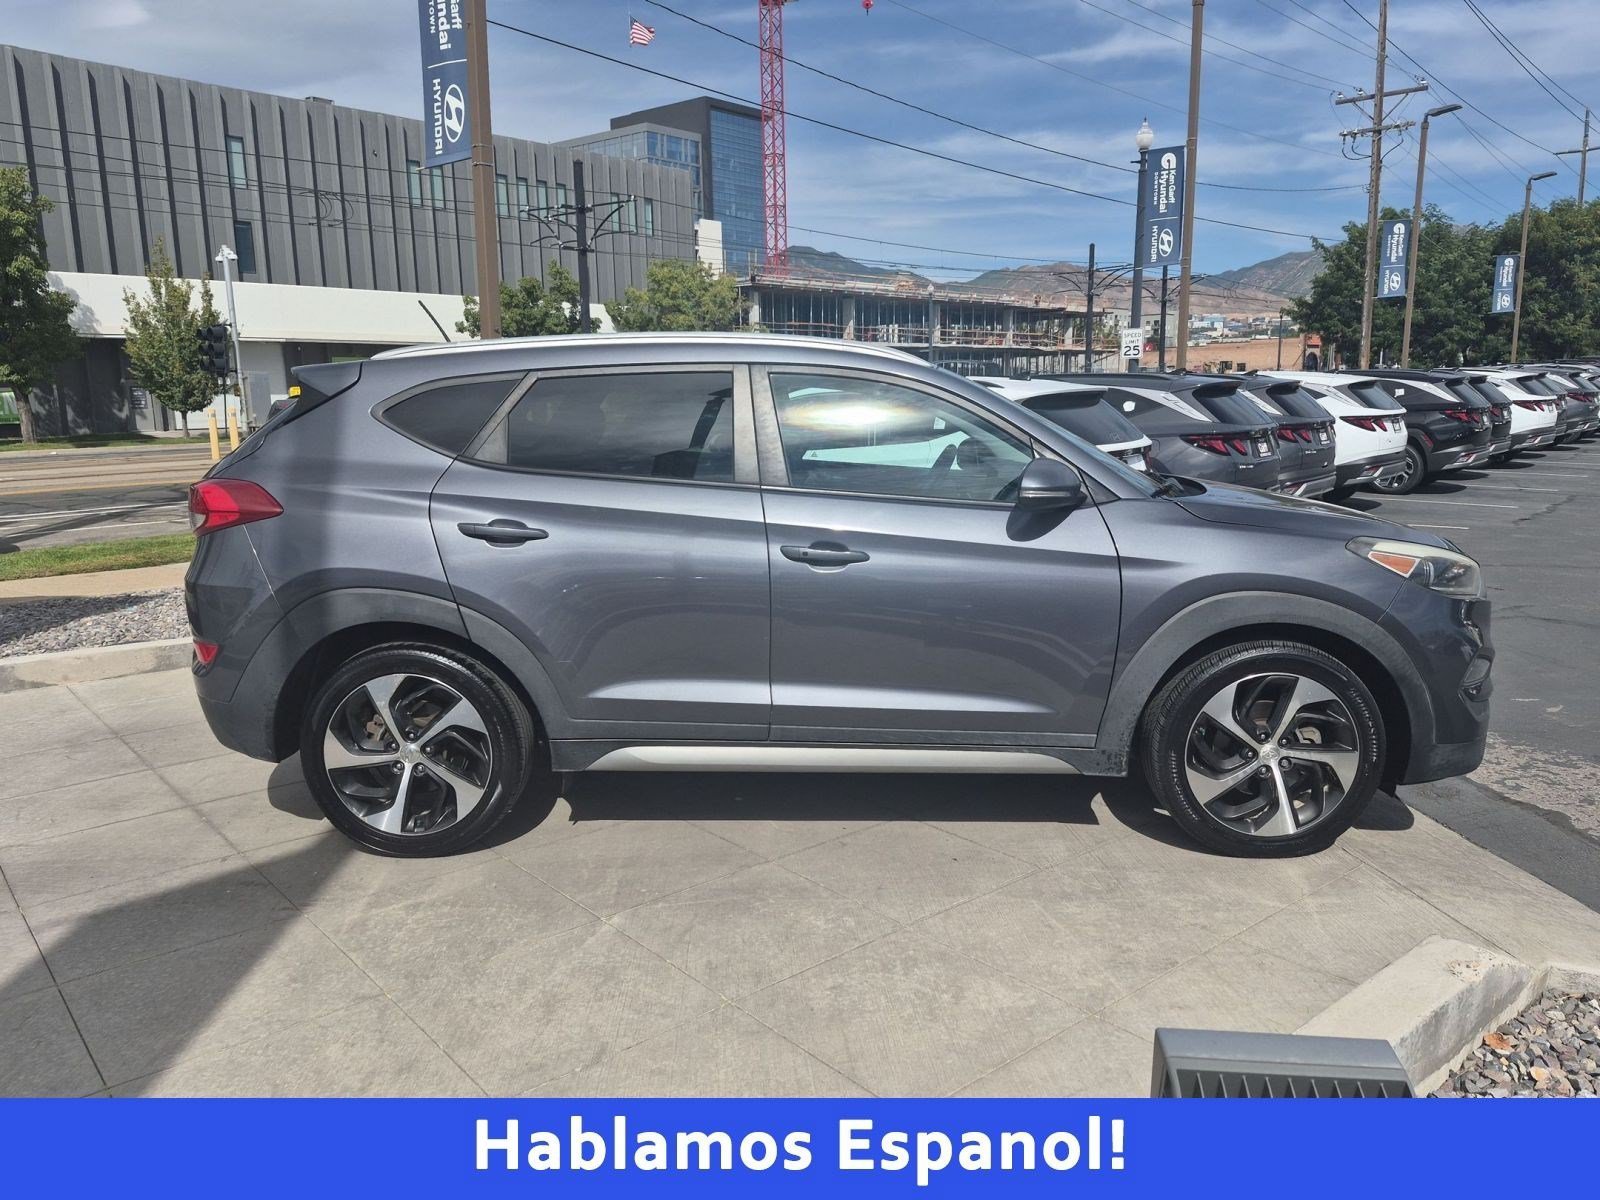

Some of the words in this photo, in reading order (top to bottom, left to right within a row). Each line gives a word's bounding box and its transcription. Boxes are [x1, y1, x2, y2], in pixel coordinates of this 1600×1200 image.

[433, 78, 443, 155] HYUNDAI
[1159, 170, 1169, 213] Hyundai
[1168, 185, 1176, 203] Garff
[1391, 235, 1399, 262] Hyundai
[1123, 345, 1140, 357] 25
